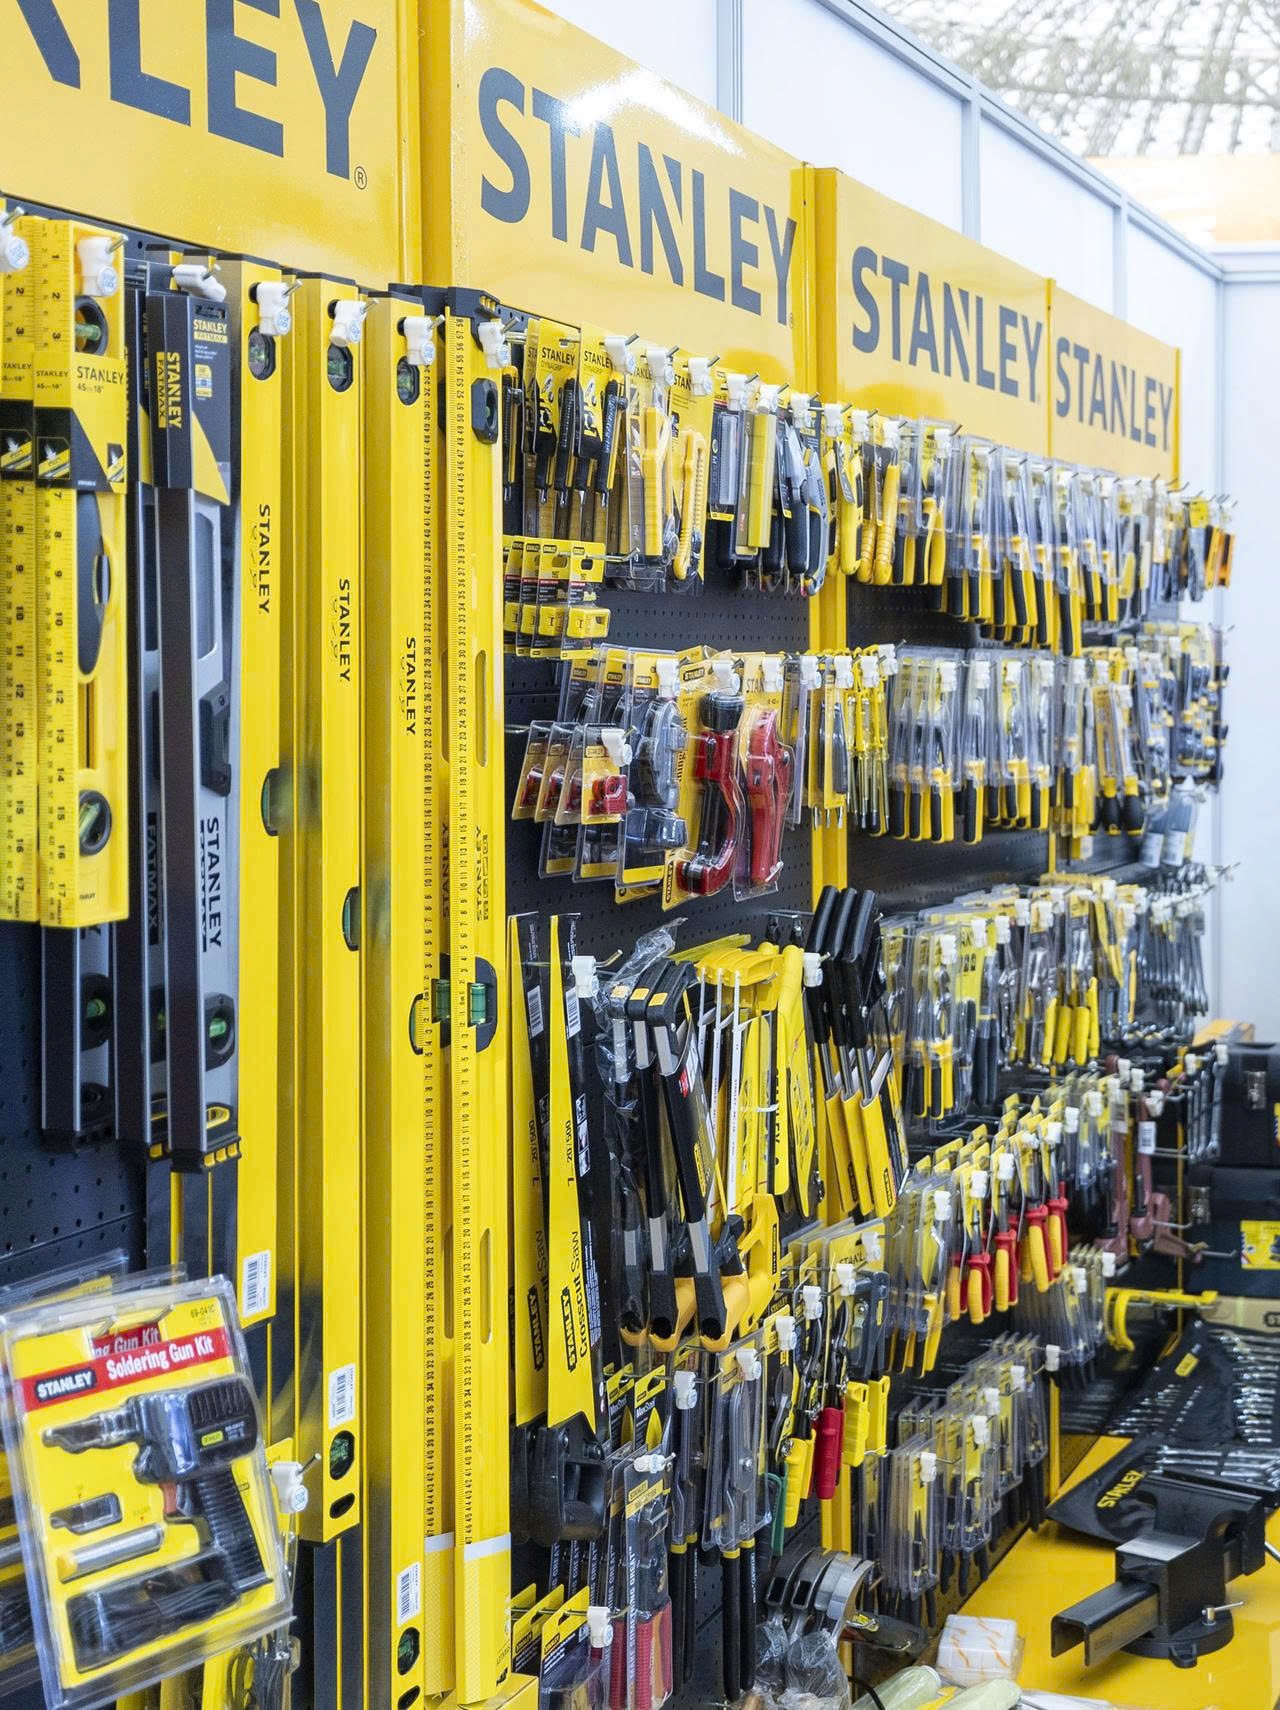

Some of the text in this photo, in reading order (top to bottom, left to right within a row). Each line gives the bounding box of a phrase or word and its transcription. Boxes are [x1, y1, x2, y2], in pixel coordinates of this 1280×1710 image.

[478, 66, 798, 328] STANLEY
[193, 319, 228, 334] STANLEY
[541, 347, 576, 366] STANLEY
[851, 245, 1043, 403] STANLEY
[76, 366, 124, 385] STANLEY
[167, 352, 183, 430] STANLEY
[634, 367, 653, 381] TANLE
[673, 374, 692, 391] STAN
[1056, 337, 1174, 453] STANLEY
[259, 504, 271, 614] STANLEY
[339, 578, 351, 682] STANLEY
[406, 637, 416, 735] STANLEY
[684, 668, 704, 680] STANLEY
[207, 817, 222, 948] STANLEY
[884, 1171, 893, 1205] STANLEY
[839, 1252, 865, 1264] STANL
[529, 1290, 543, 1370] STANLEY
[562, 1289, 576, 1370] STANLEY
[571, 1231, 587, 1358] Crosscut Saw
[37, 1374, 93, 1399] STANLEY
[105, 1347, 170, 1381] Soldering
[169, 1342, 195, 1365] Gun
[194, 1335, 215, 1355] Kit
[142, 1327, 160, 1347] Kit
[1096, 1469, 1145, 1509] STANLEY
